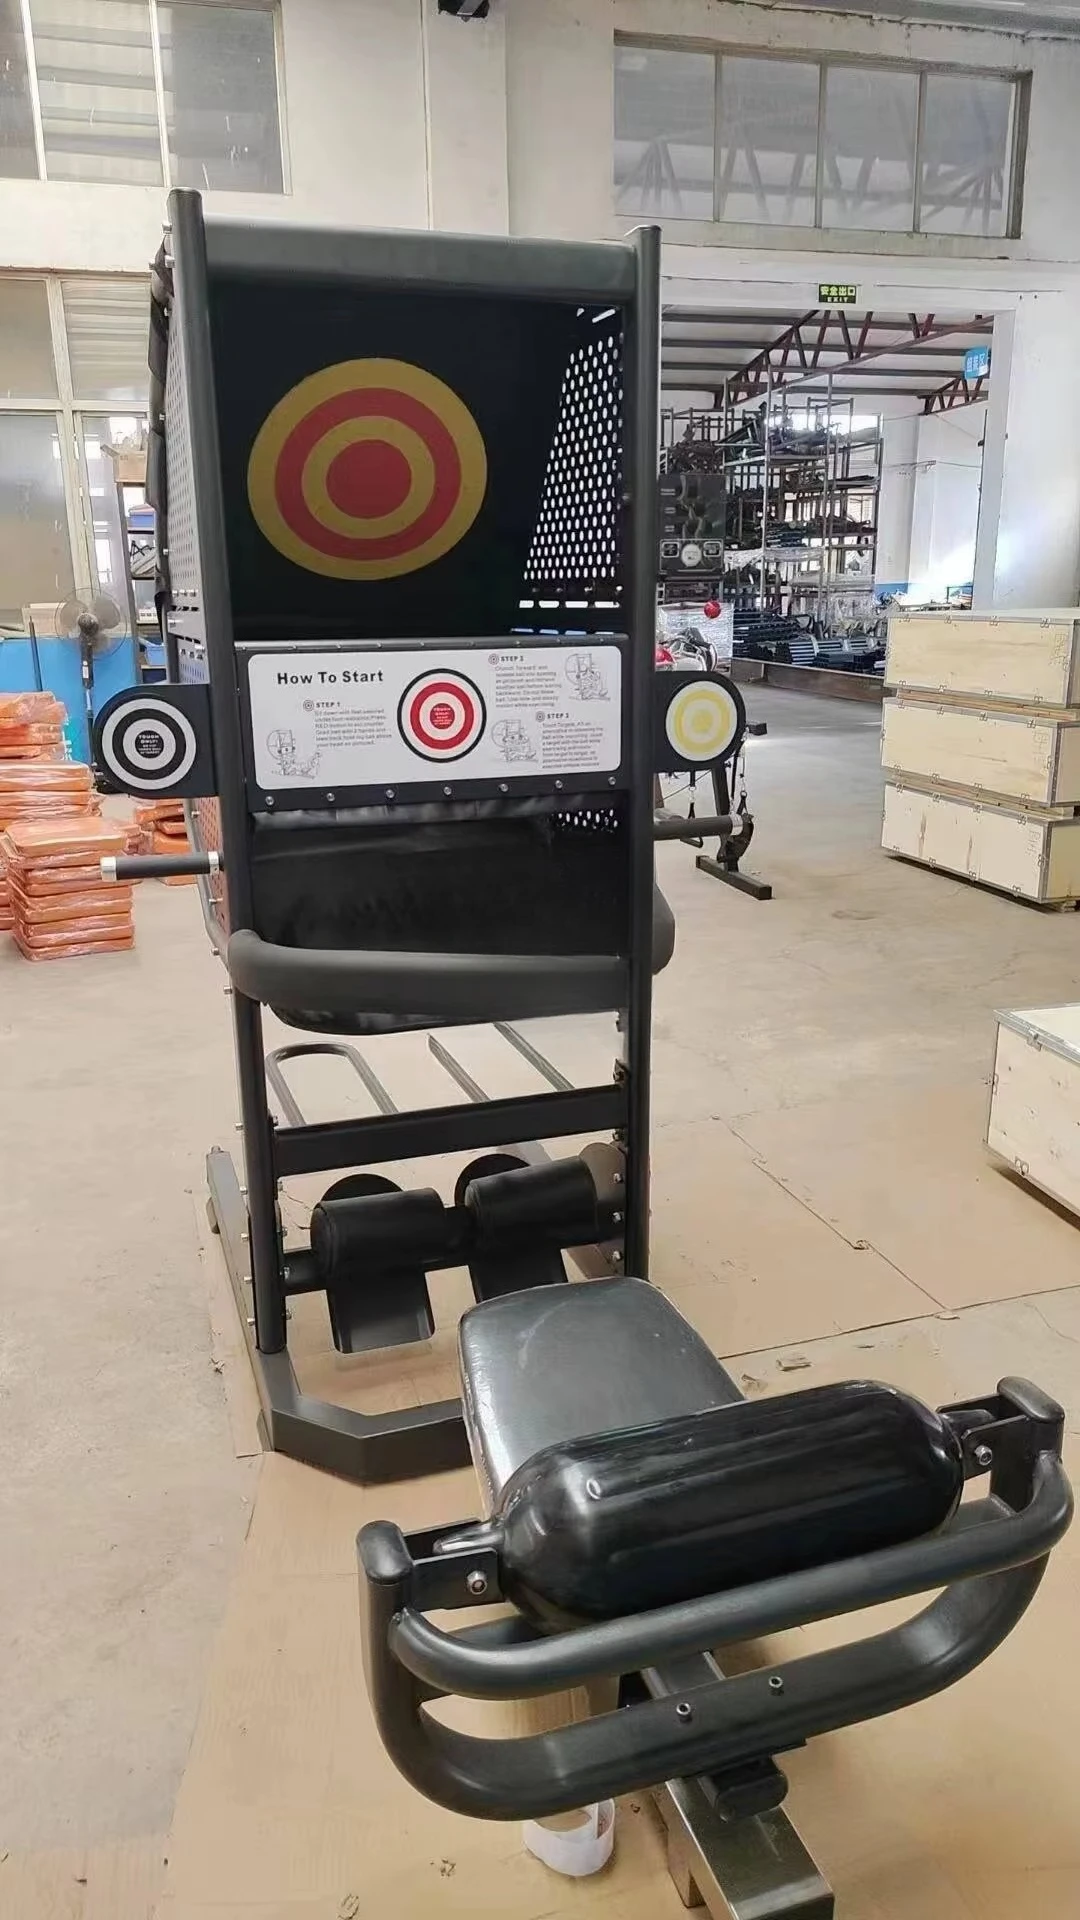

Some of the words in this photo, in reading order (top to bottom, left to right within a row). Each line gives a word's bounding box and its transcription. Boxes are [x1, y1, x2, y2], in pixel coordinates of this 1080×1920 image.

[820, 285, 856, 296] 安全出口
[277, 672, 313, 685] How
[317, 671, 337, 684] To
[342, 670, 383, 683] Start
